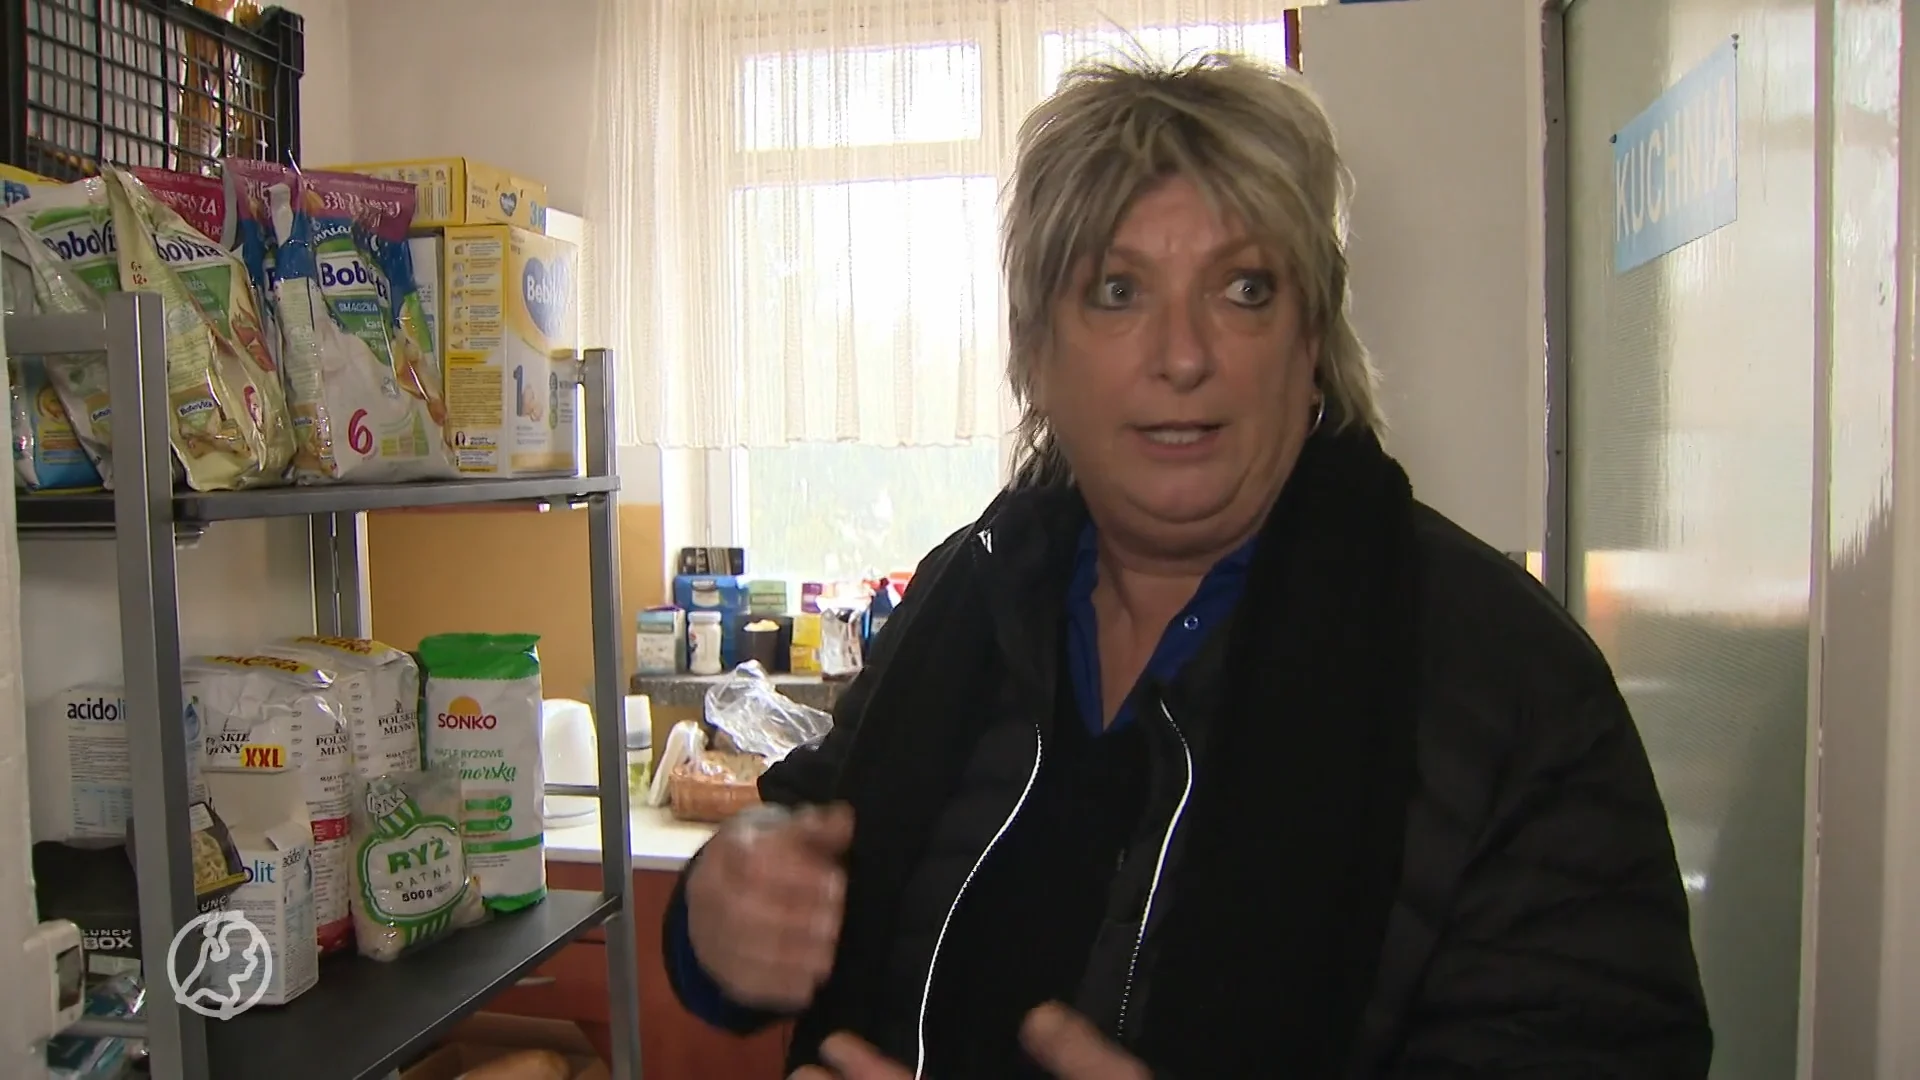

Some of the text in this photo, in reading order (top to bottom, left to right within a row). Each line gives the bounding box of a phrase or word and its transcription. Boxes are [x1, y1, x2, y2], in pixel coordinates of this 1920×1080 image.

[1616, 76, 1734, 243] KUCHNIA
[513, 364, 523, 416] 1
[348, 408, 373, 454] 6
[67, 697, 126, 721] acidoli
[438, 713, 497, 730] SONKO
[245, 747, 284, 768] XXL
[83, 936, 134, 950] BOX
